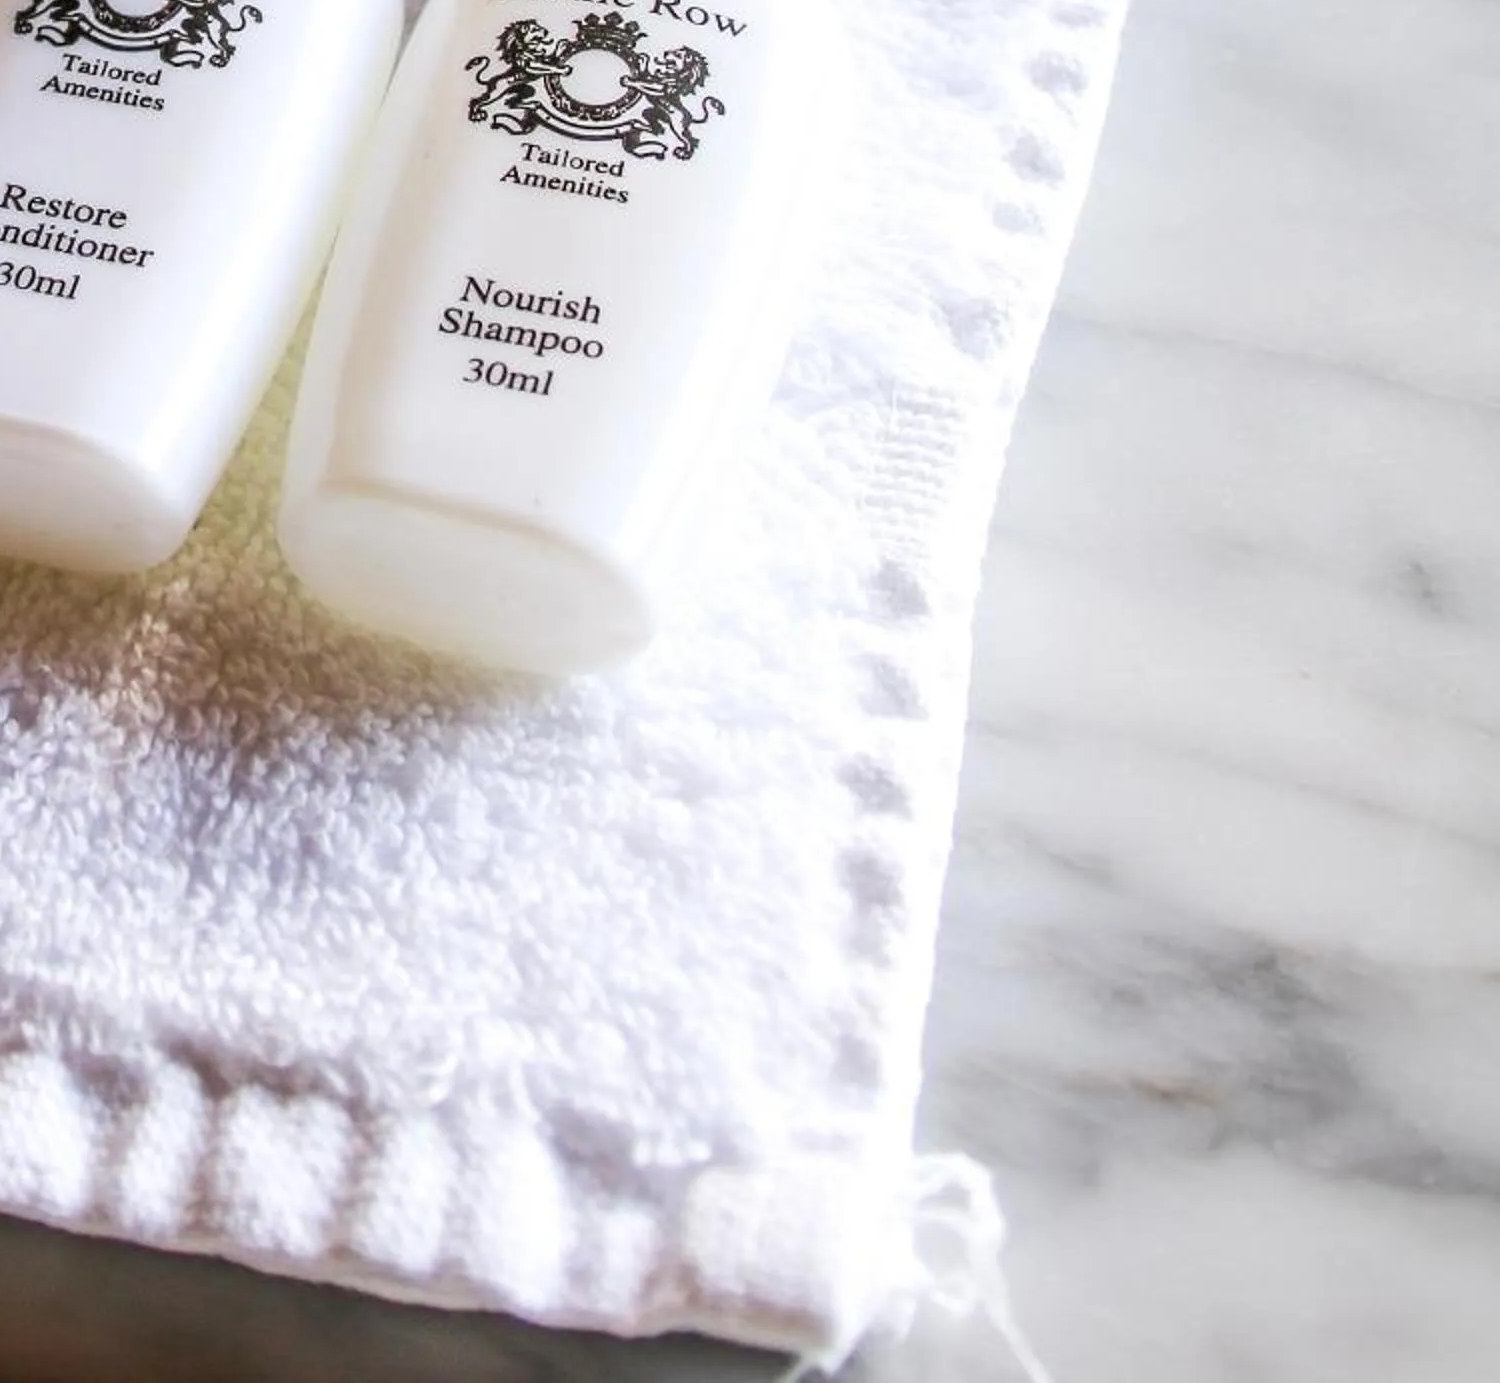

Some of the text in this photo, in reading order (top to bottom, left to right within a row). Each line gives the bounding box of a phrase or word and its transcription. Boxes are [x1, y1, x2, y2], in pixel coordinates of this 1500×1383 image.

[62, 53, 162, 86] Tailored
[40, 75, 165, 111] Amenities
[521, 143, 625, 177] Tailored
[500, 165, 629, 203] Amenities
[0, 183, 127, 228] Restore
[459, 276, 601, 324] Nourish
[438, 308, 604, 359] Shampoo
[462, 358, 554, 395] 30ml
